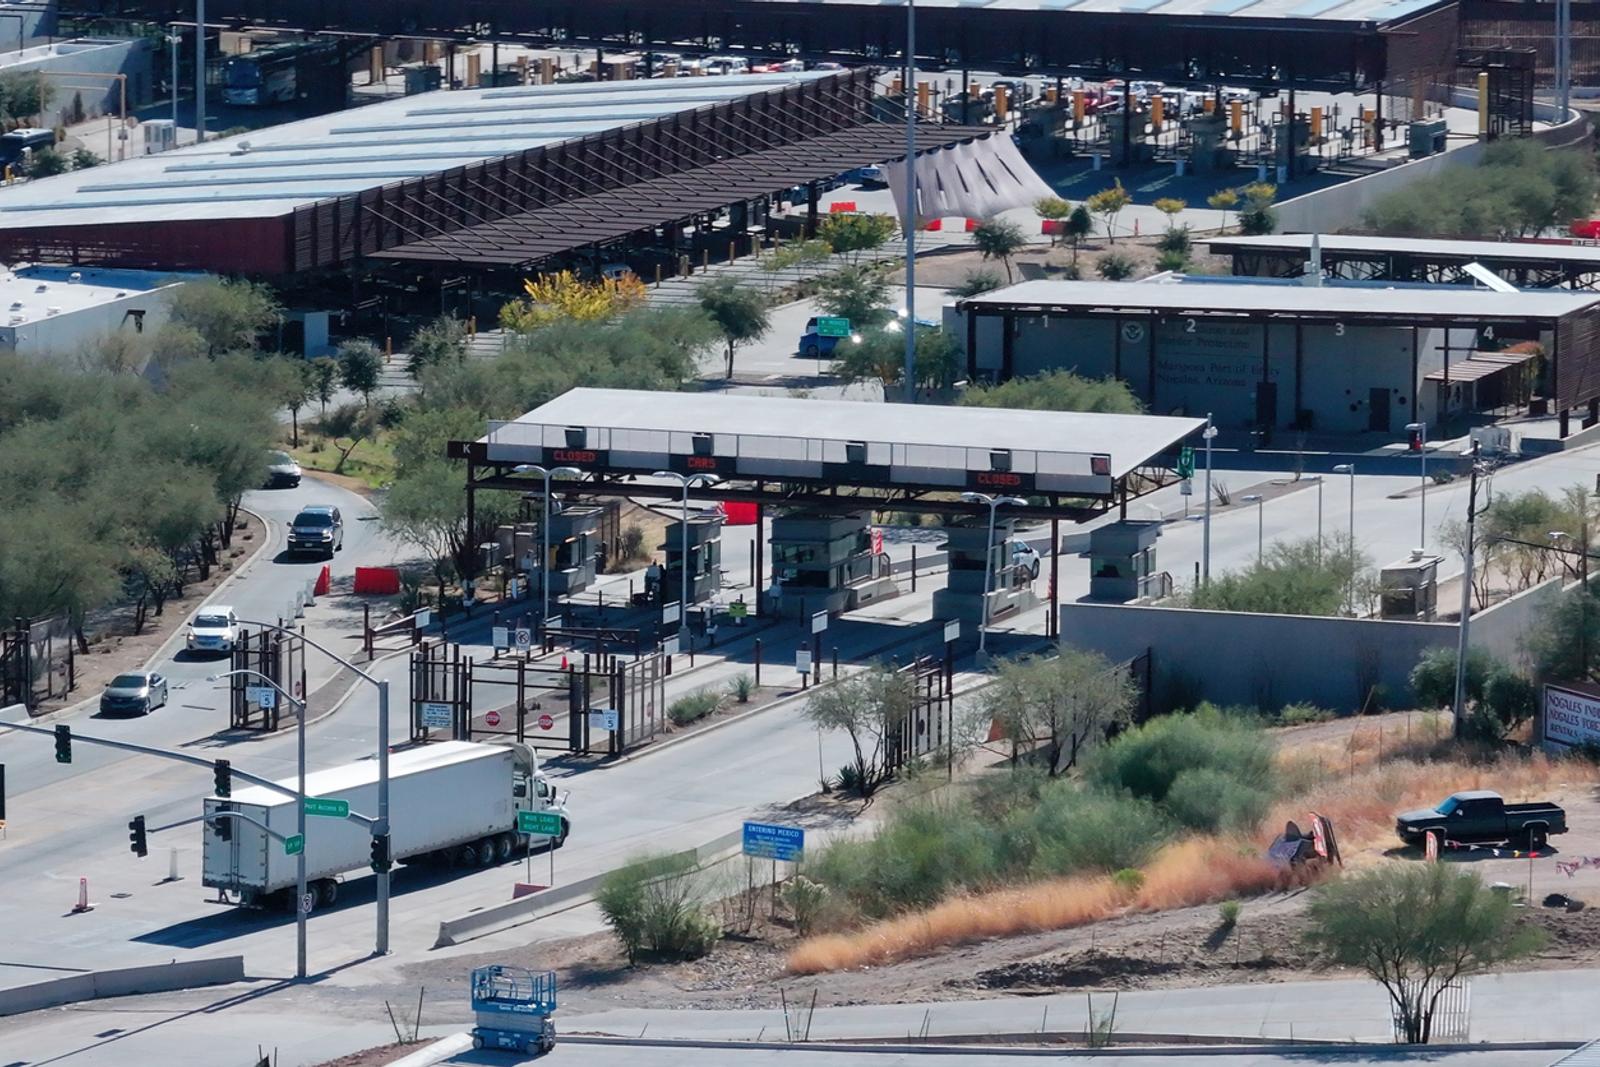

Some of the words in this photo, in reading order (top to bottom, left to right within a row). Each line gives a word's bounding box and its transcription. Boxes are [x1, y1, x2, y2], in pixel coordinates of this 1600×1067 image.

[1041, 315, 1049, 328] 1
[1186, 318, 1196, 333] 2
[1335, 322, 1345, 336] 3
[1483, 326, 1494, 340] 4
[463, 443, 471, 454] K
[553, 450, 596, 462] CLOSED
[687, 457, 716, 468] CARS
[976, 472, 1021, 486] CLOSED
[264, 697, 270, 705] 5
[1548, 694, 1582, 714] NOGALES
[1549, 708, 1579, 726] NOGALES
[607, 720, 614, 728] 5
[748, 825, 776, 835] ENTERING
[777, 829, 800, 838] MEXICO
